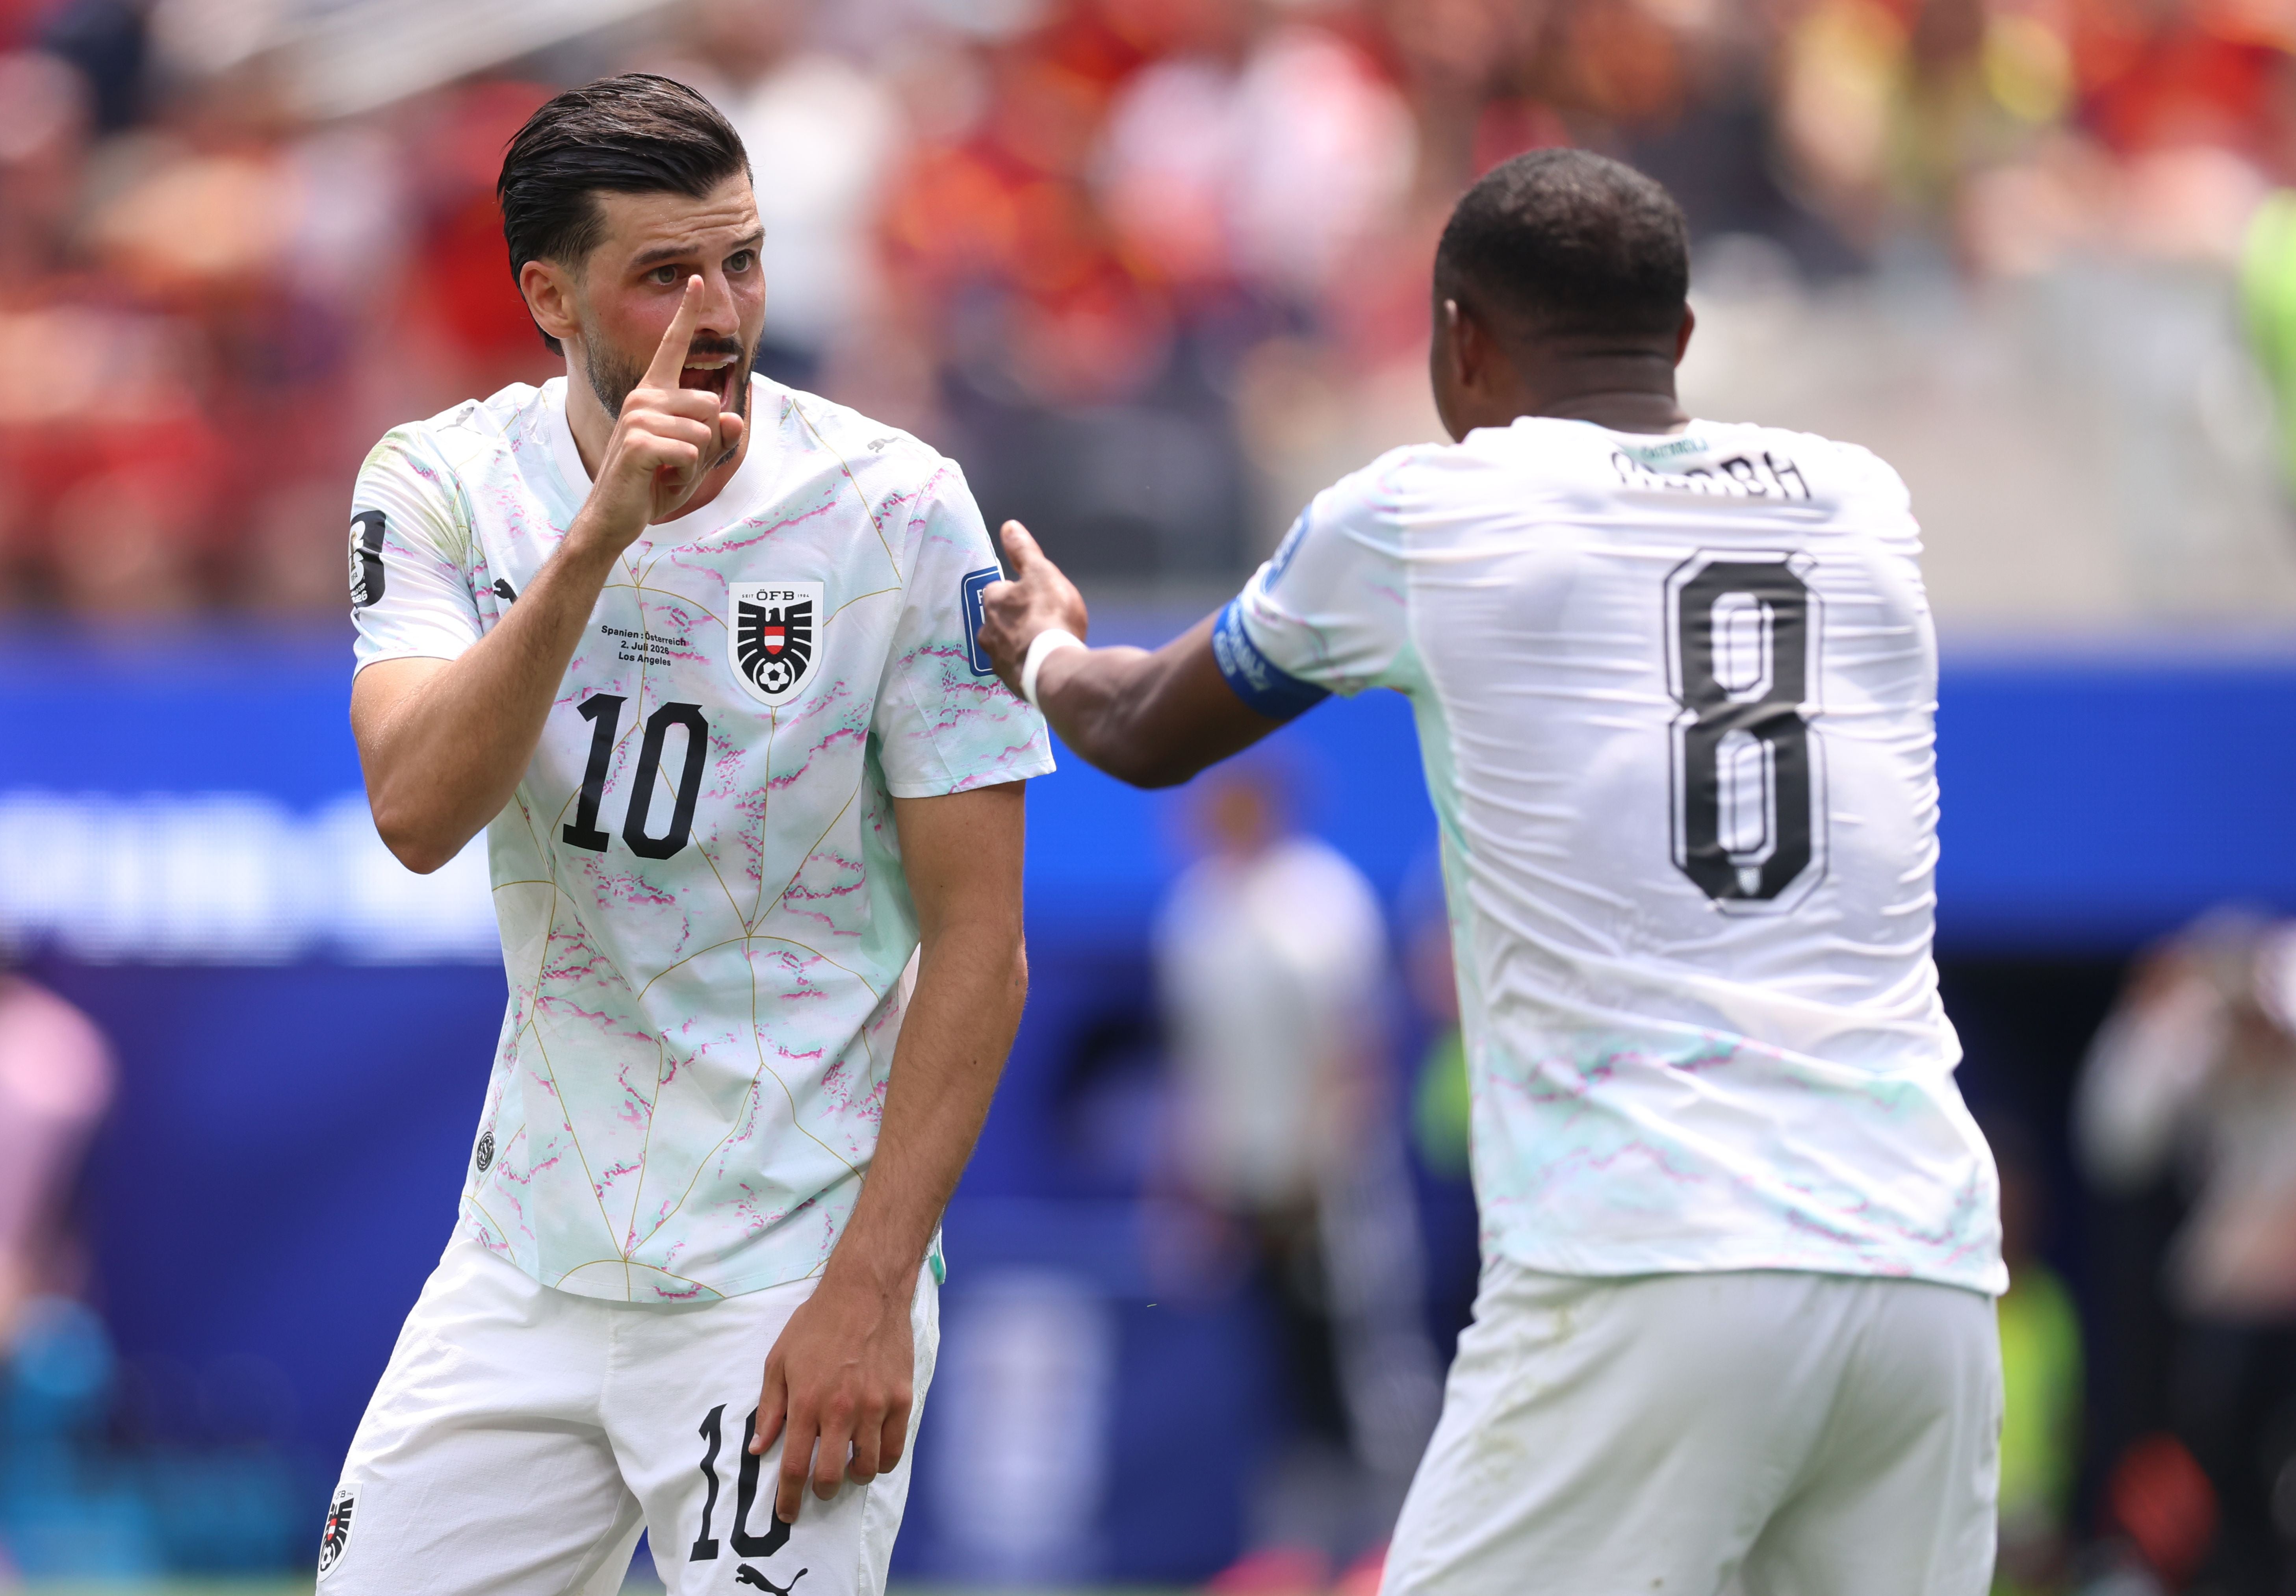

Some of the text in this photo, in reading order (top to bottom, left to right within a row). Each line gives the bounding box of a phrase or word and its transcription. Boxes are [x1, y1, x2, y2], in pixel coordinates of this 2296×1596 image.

[352, 590, 368, 604] 26
[757, 589, 794, 601] ÖFB
[601, 625, 638, 638] Spanien
[645, 631, 686, 646] Österreich
[621, 641, 670, 655] 2. Juli 2026
[618, 652, 671, 666] Los Angeles
[1663, 548, 1829, 917] 8
[563, 693, 709, 860] 10
[689, 1403, 791, 1562] 10
